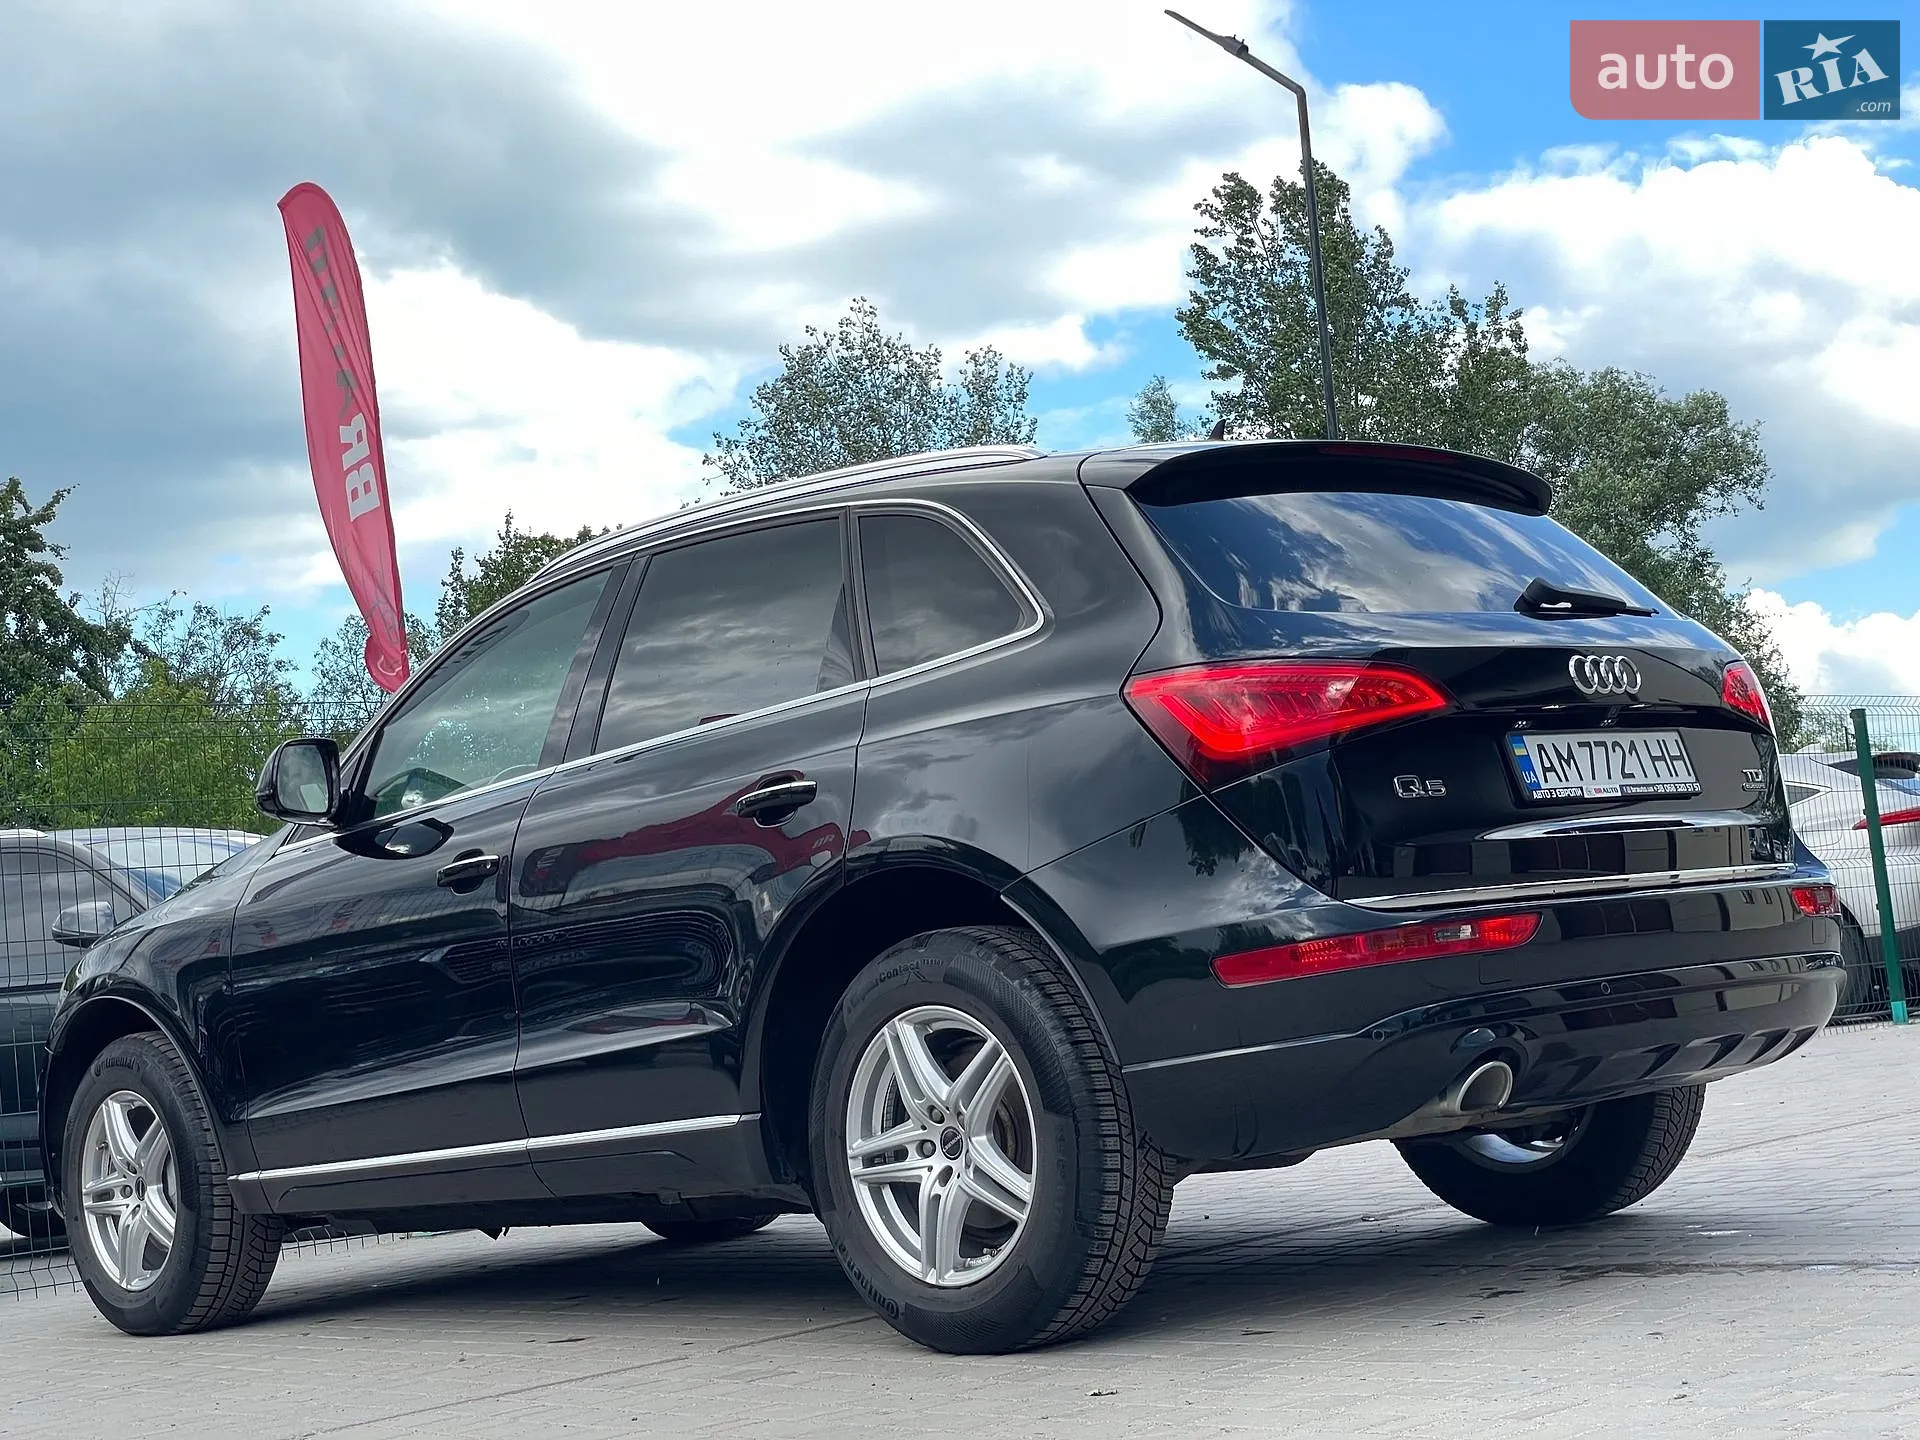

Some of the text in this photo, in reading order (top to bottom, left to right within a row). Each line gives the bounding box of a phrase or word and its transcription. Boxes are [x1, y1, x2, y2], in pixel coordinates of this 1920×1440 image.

[1522, 770, 1537, 784] UA
[1393, 775, 1447, 798] Q5
[1532, 789, 1551, 799] АВТО
